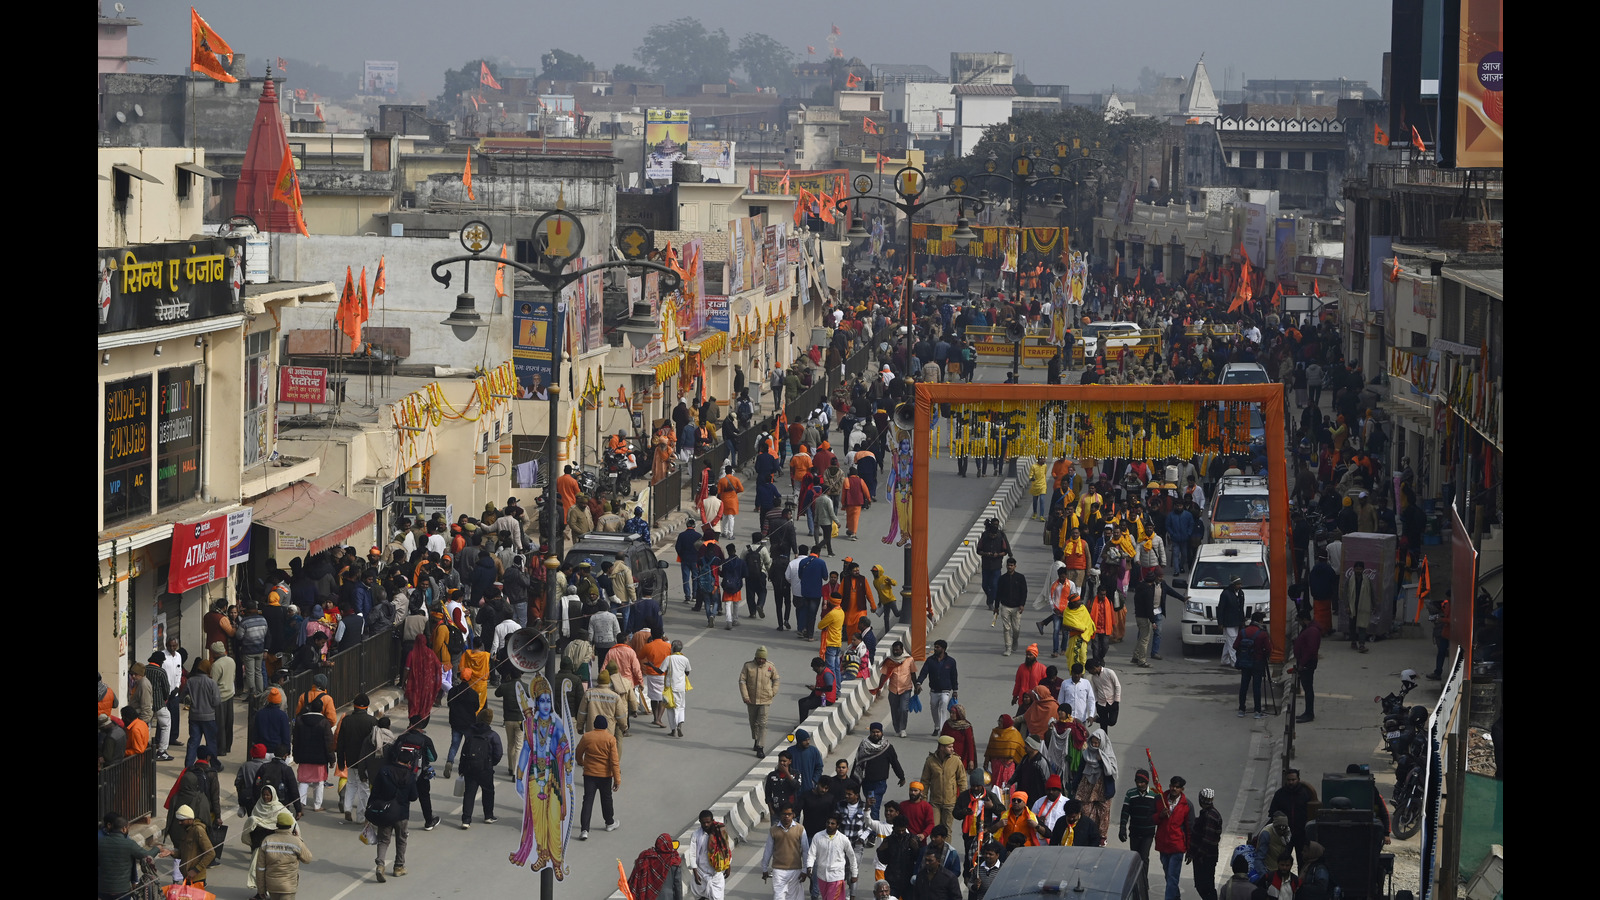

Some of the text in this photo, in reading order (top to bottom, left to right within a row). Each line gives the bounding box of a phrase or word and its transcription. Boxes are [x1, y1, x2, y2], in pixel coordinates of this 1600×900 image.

[1482, 62, 1501, 71] आज
[121, 244, 225, 294] सिन्ध ए पंजाब
[108, 386, 147, 422] SINDH-A
[109, 422, 146, 460] PUNJAB
[159, 464, 177, 480] DINING
[182, 458, 197, 473] HALL
[109, 480, 121, 494] VIP
[134, 473, 144, 487] AC
[205, 538, 220, 550] Opening
[183, 541, 207, 569] ATM
[204, 550, 218, 562] Shortly
